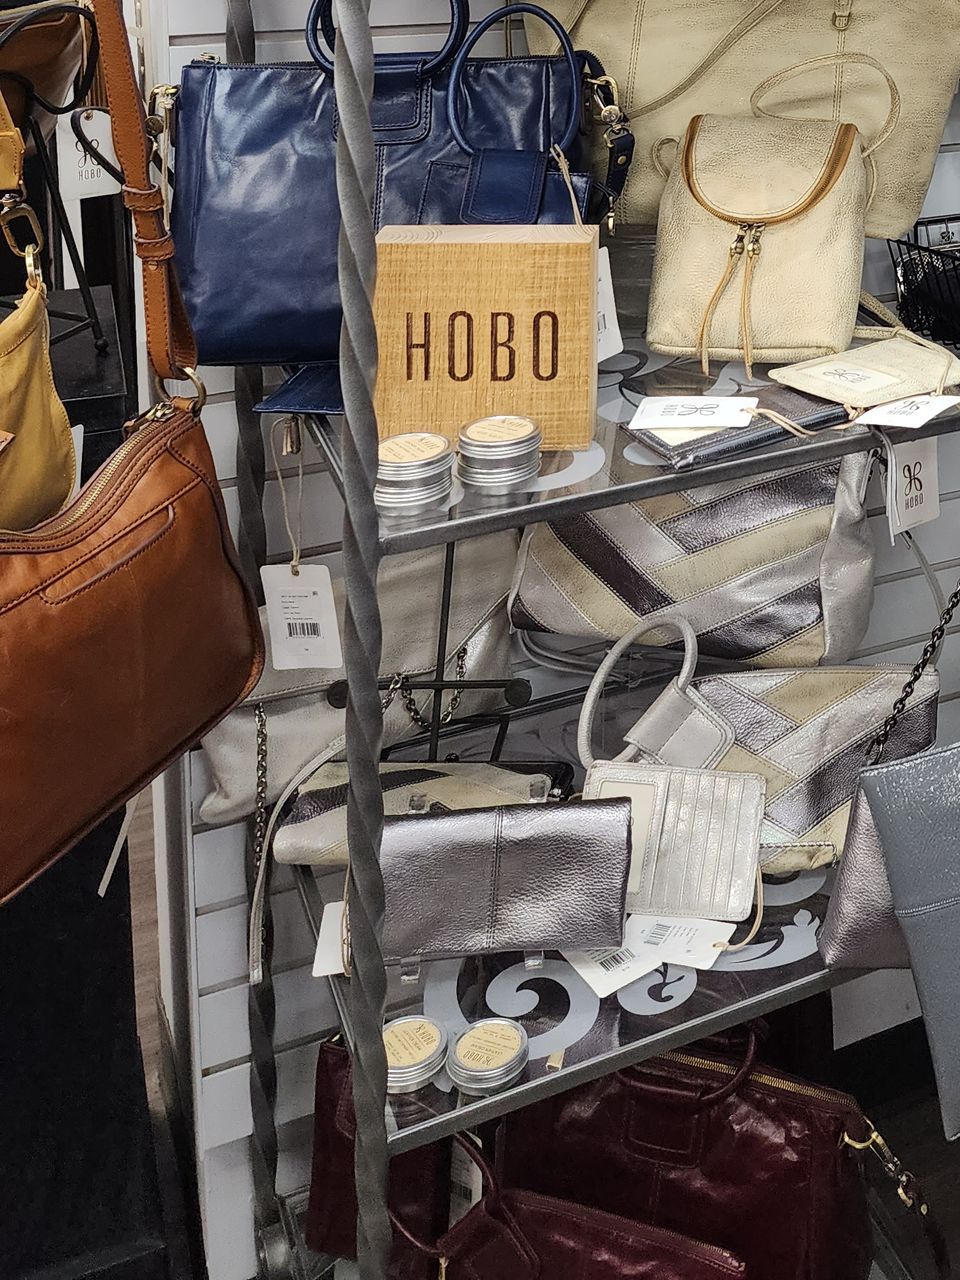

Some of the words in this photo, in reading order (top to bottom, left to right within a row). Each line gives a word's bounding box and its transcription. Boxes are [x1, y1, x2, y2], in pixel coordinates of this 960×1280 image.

[78, 168, 101, 181] HOBO
[406, 310, 559, 382] HOBO
[904, 493, 924, 511] HOBO
[463, 1050, 484, 1063] HOBO
